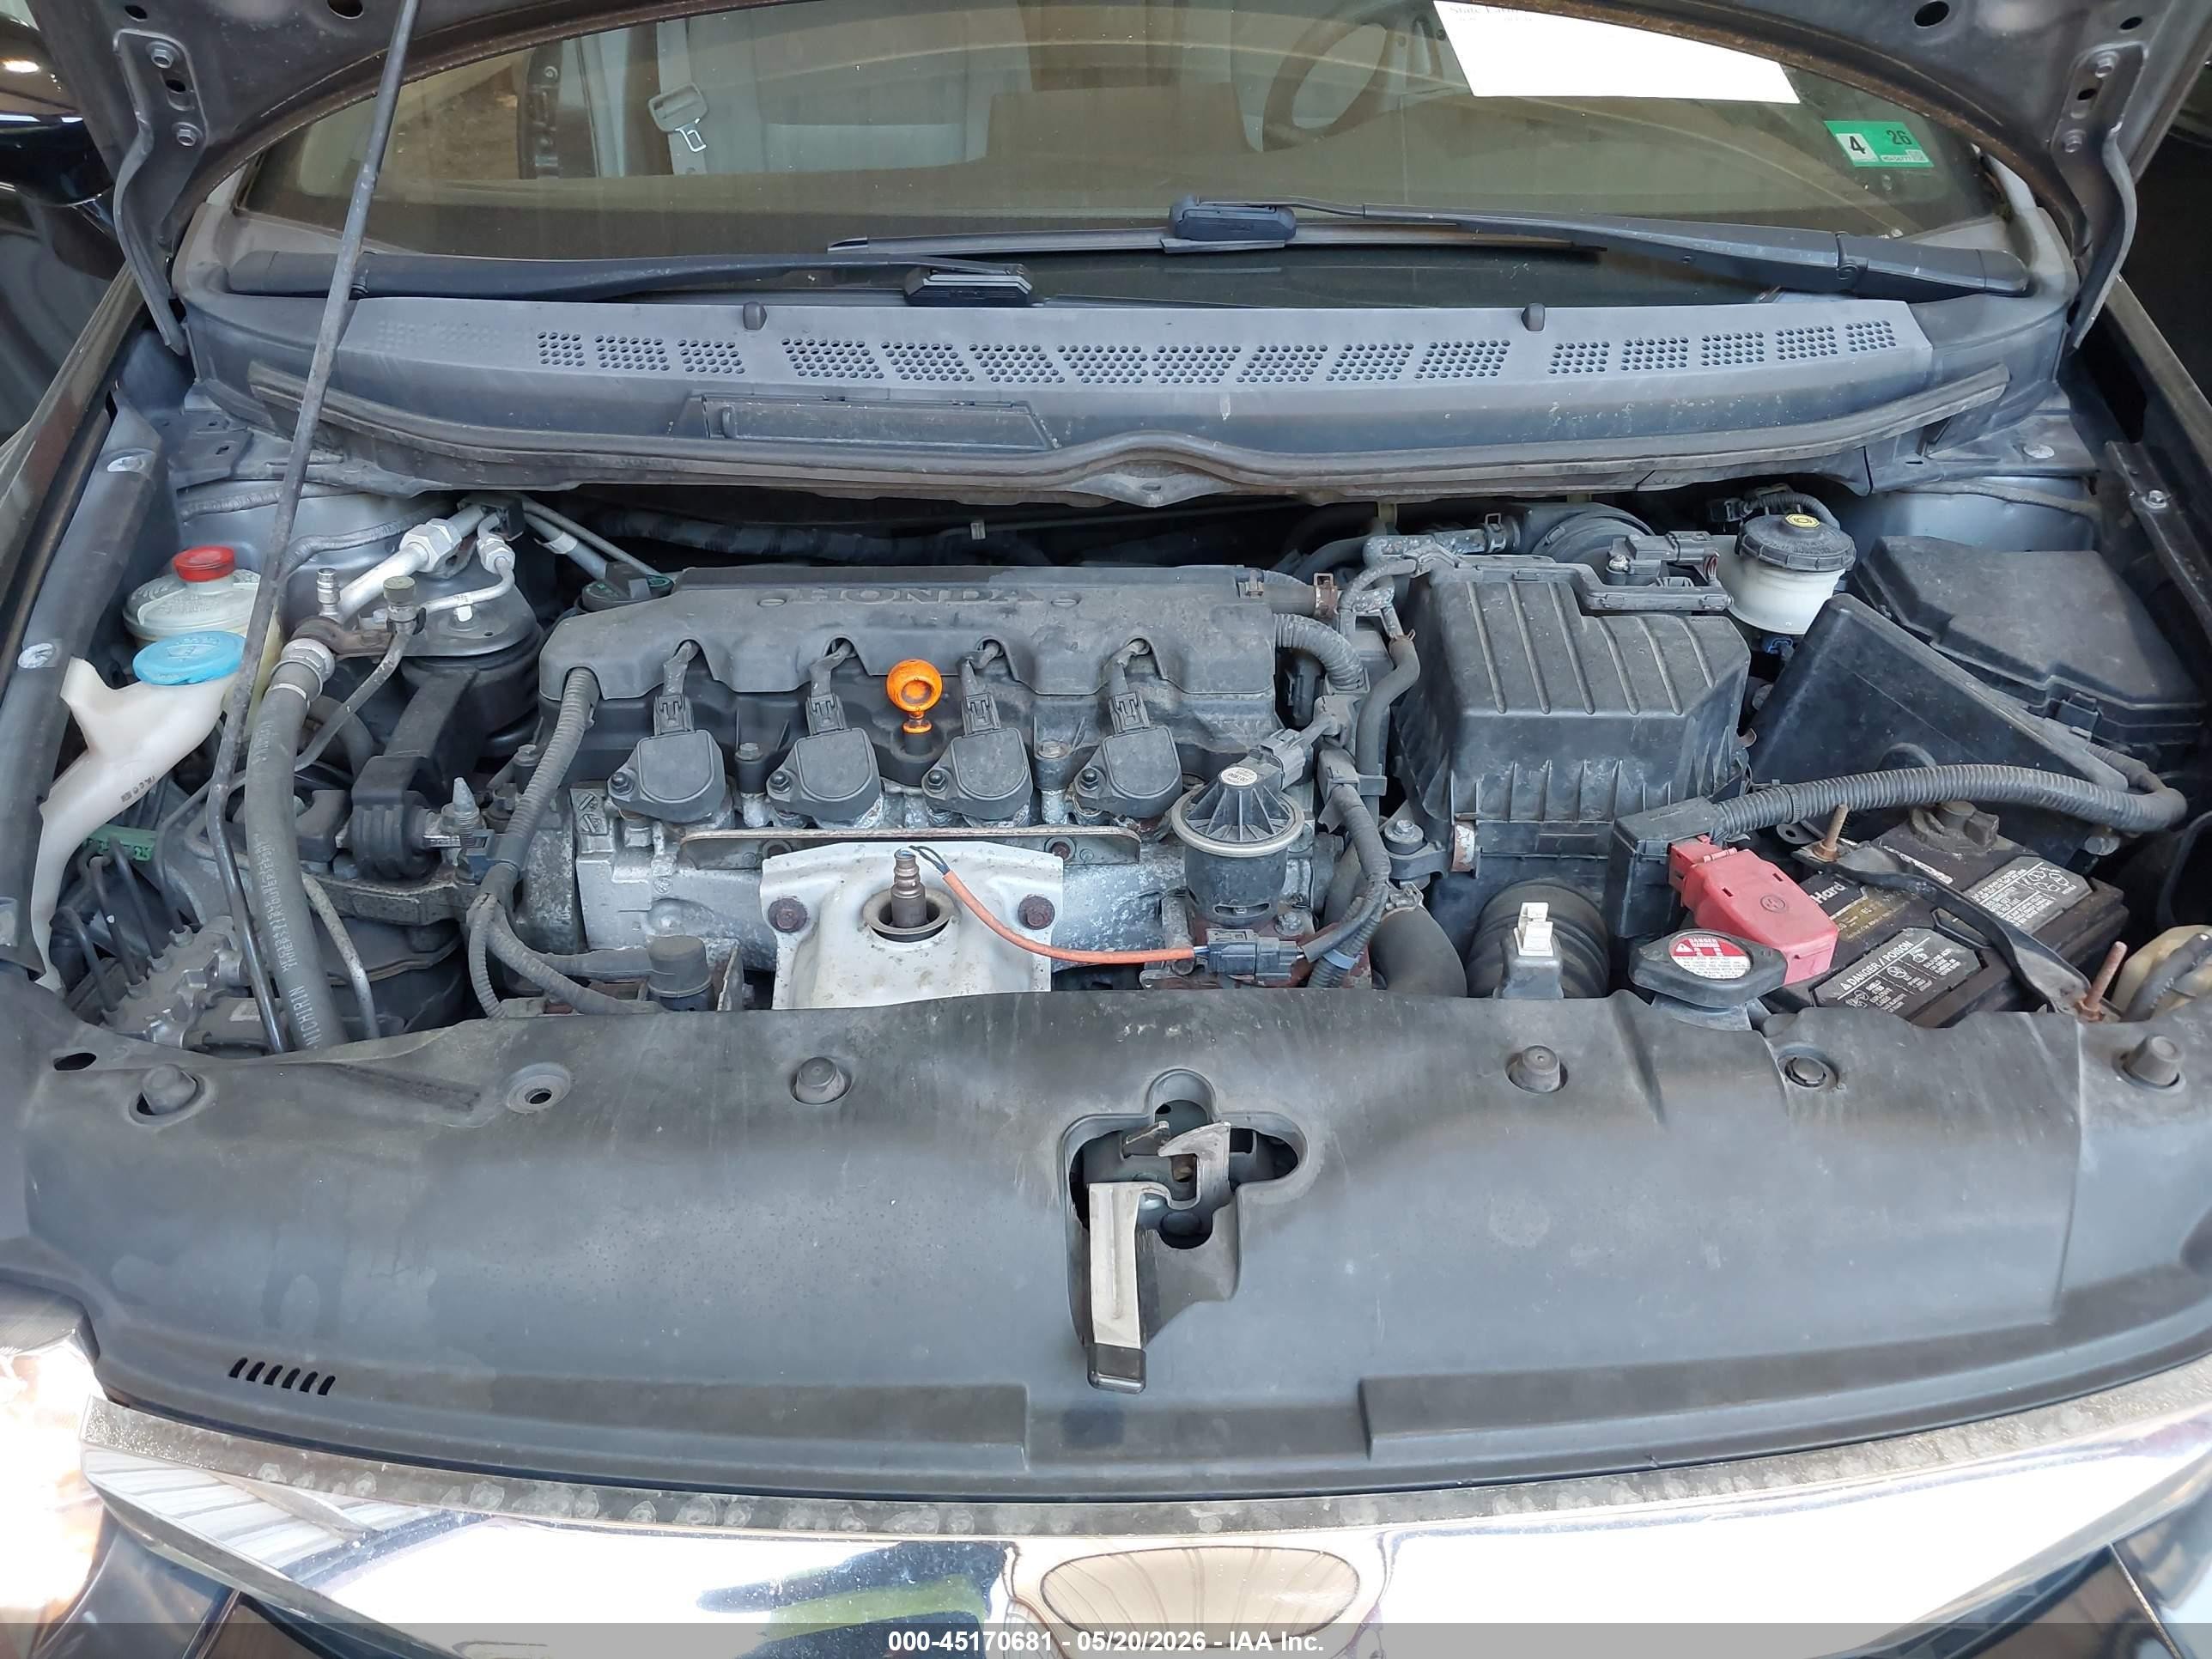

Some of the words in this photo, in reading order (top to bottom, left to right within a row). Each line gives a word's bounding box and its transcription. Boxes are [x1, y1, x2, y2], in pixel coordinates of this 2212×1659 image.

[1849, 136, 1866, 155] 4
[1886, 130, 1912, 145] 26
[796, 588, 1040, 605] HONDA
[1847, 959, 1882, 987] DANGER
[1885, 940, 1914, 962] POISON
[289, 985, 323, 1047] NICHIRIN
